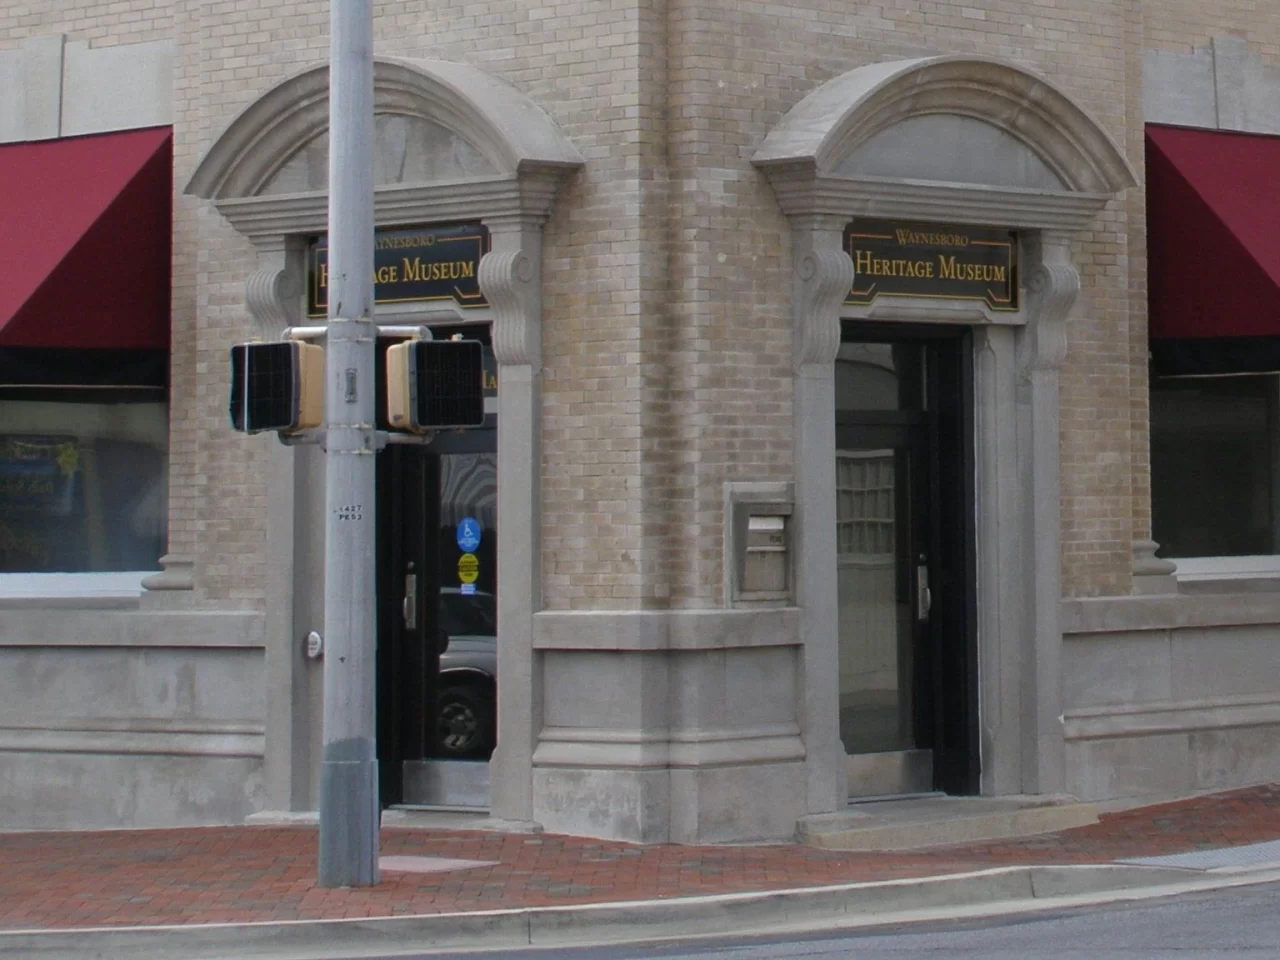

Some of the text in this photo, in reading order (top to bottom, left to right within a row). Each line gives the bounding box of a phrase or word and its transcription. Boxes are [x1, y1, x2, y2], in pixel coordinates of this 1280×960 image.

[375, 234, 436, 250] AYNESBORO
[896, 229, 969, 246] WAYNESBORO
[403, 257, 474, 281] MUSEUM
[856, 251, 1006, 281] HERITAGE MUSEUM
